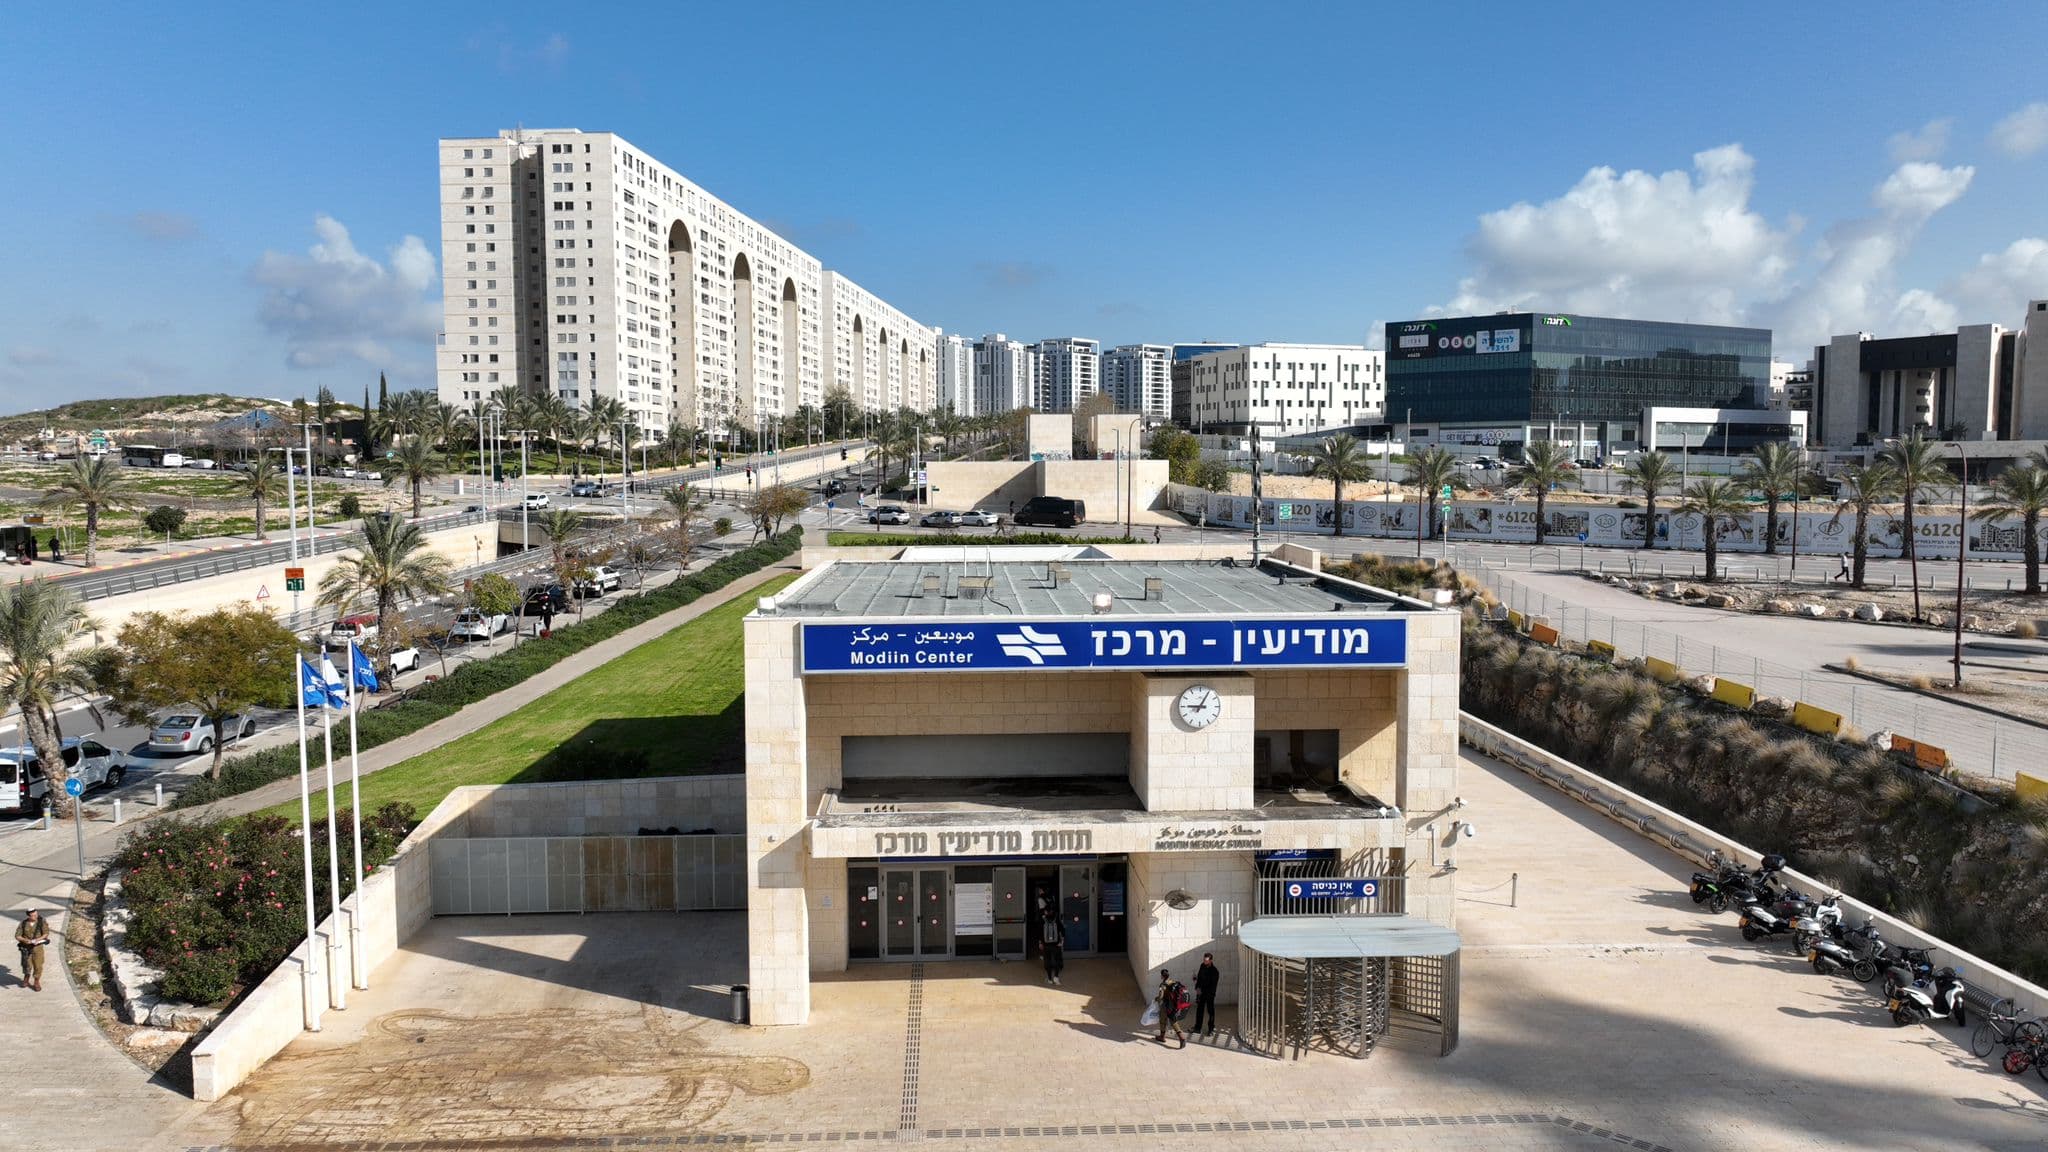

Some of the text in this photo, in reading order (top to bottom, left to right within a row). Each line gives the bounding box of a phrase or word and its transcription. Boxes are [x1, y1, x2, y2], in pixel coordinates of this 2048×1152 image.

[1482, 335, 1513, 344] להשה
[850, 627, 889, 646] مركز
[915, 630, 975, 644] موديعين
[1091, 629, 1186, 657] מרכז
[1233, 628, 1369, 662] מודיעין
[850, 651, 973, 664] Modiin Center
[875, 829, 1092, 856] תחנת מודיעין מרכז
[1190, 840, 1225, 849] MERKAZ
[1226, 839, 1262, 849] STATION
[1311, 882, 1353, 891] אין כניסה
